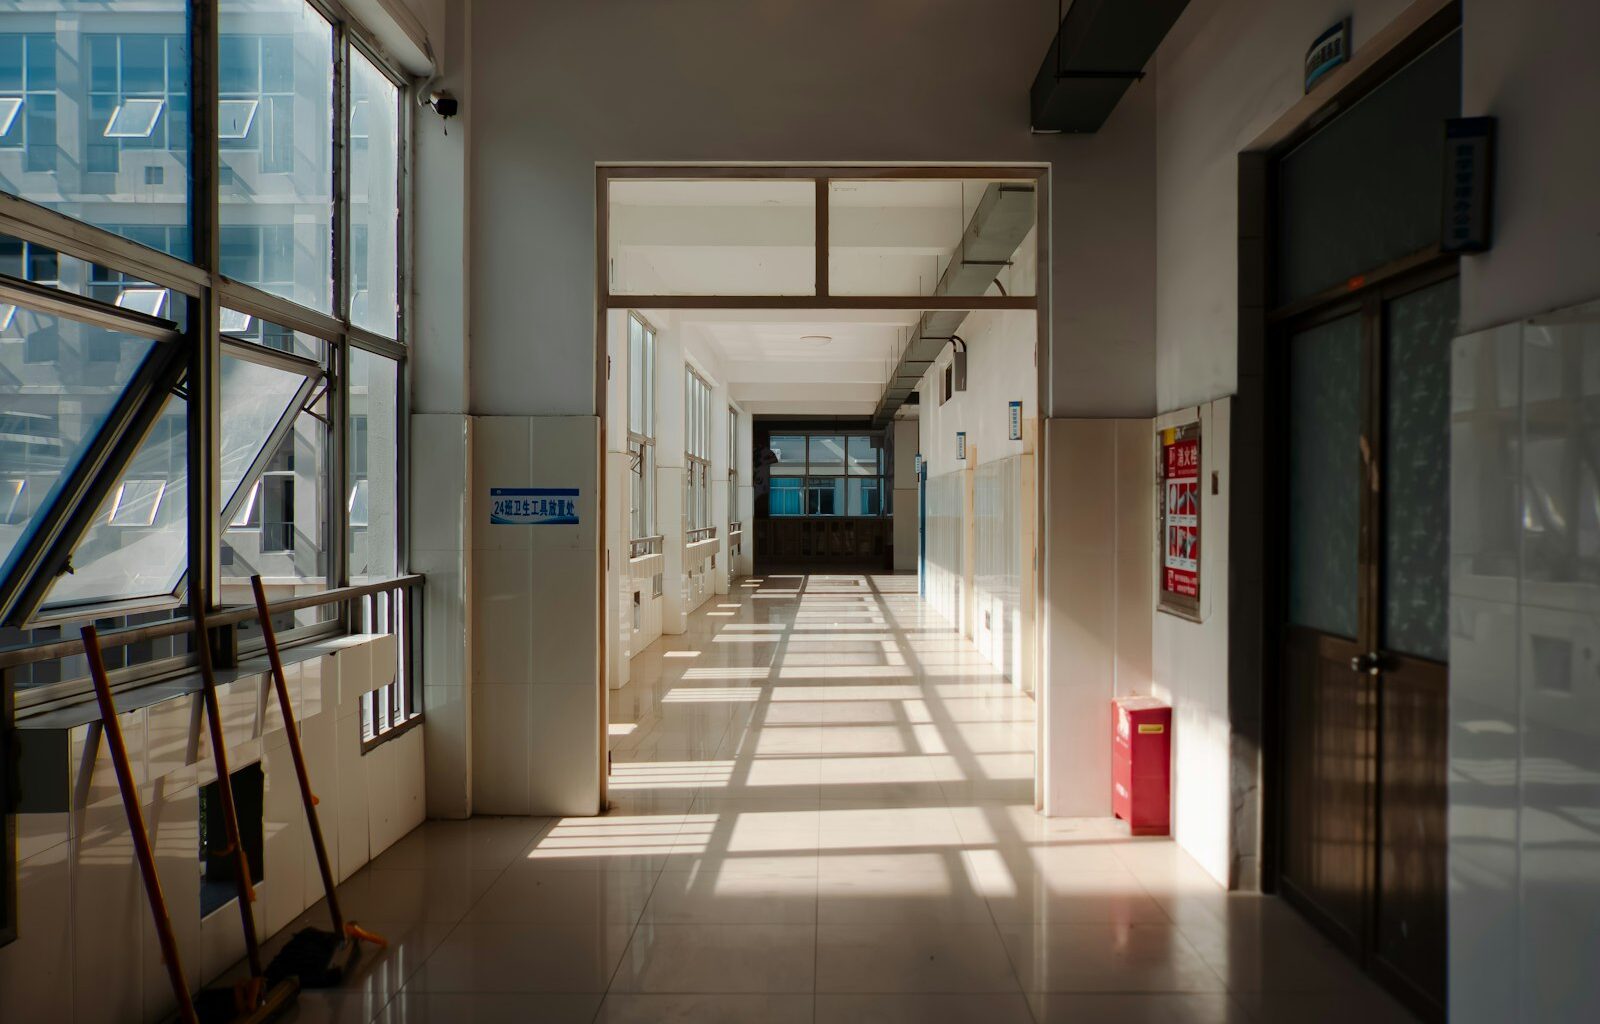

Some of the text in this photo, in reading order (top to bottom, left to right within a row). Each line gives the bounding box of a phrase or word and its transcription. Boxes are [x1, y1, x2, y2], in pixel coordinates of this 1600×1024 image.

[494, 498, 575, 516] 24班卫生工具放置处
